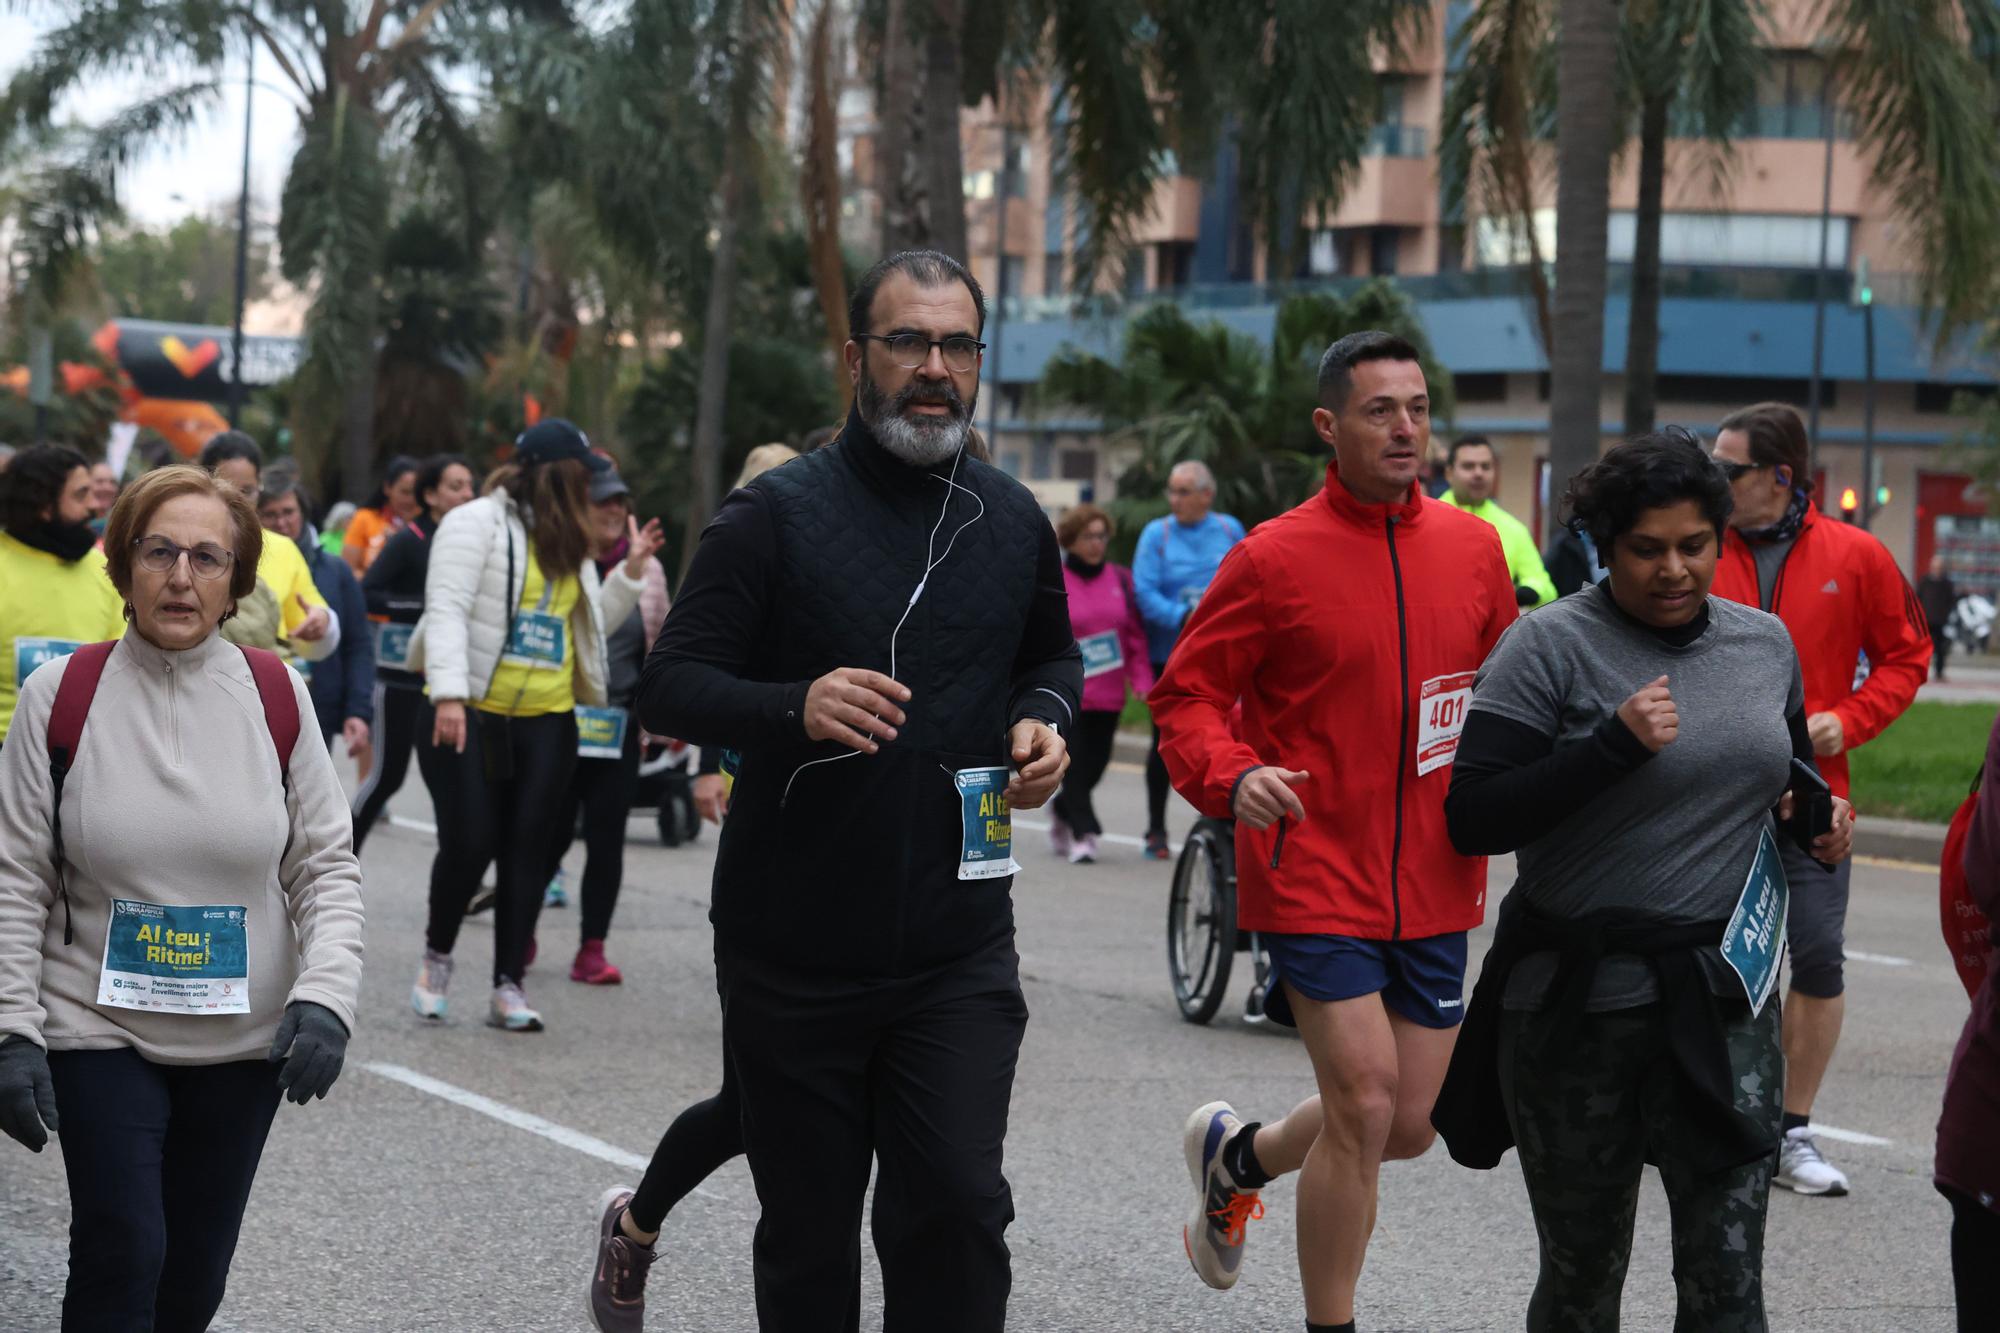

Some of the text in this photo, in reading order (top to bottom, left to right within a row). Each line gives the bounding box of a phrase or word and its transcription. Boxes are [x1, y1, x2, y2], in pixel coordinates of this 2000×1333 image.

[1429, 695, 1464, 730] 401
[978, 791, 1010, 817] Al te
[1743, 874, 1771, 953] Al teu
[1757, 888, 1779, 955] Ritme
[136, 923, 200, 947] Al teu
[146, 945, 204, 966] Ritme
[152, 980, 209, 991] Persones majors
